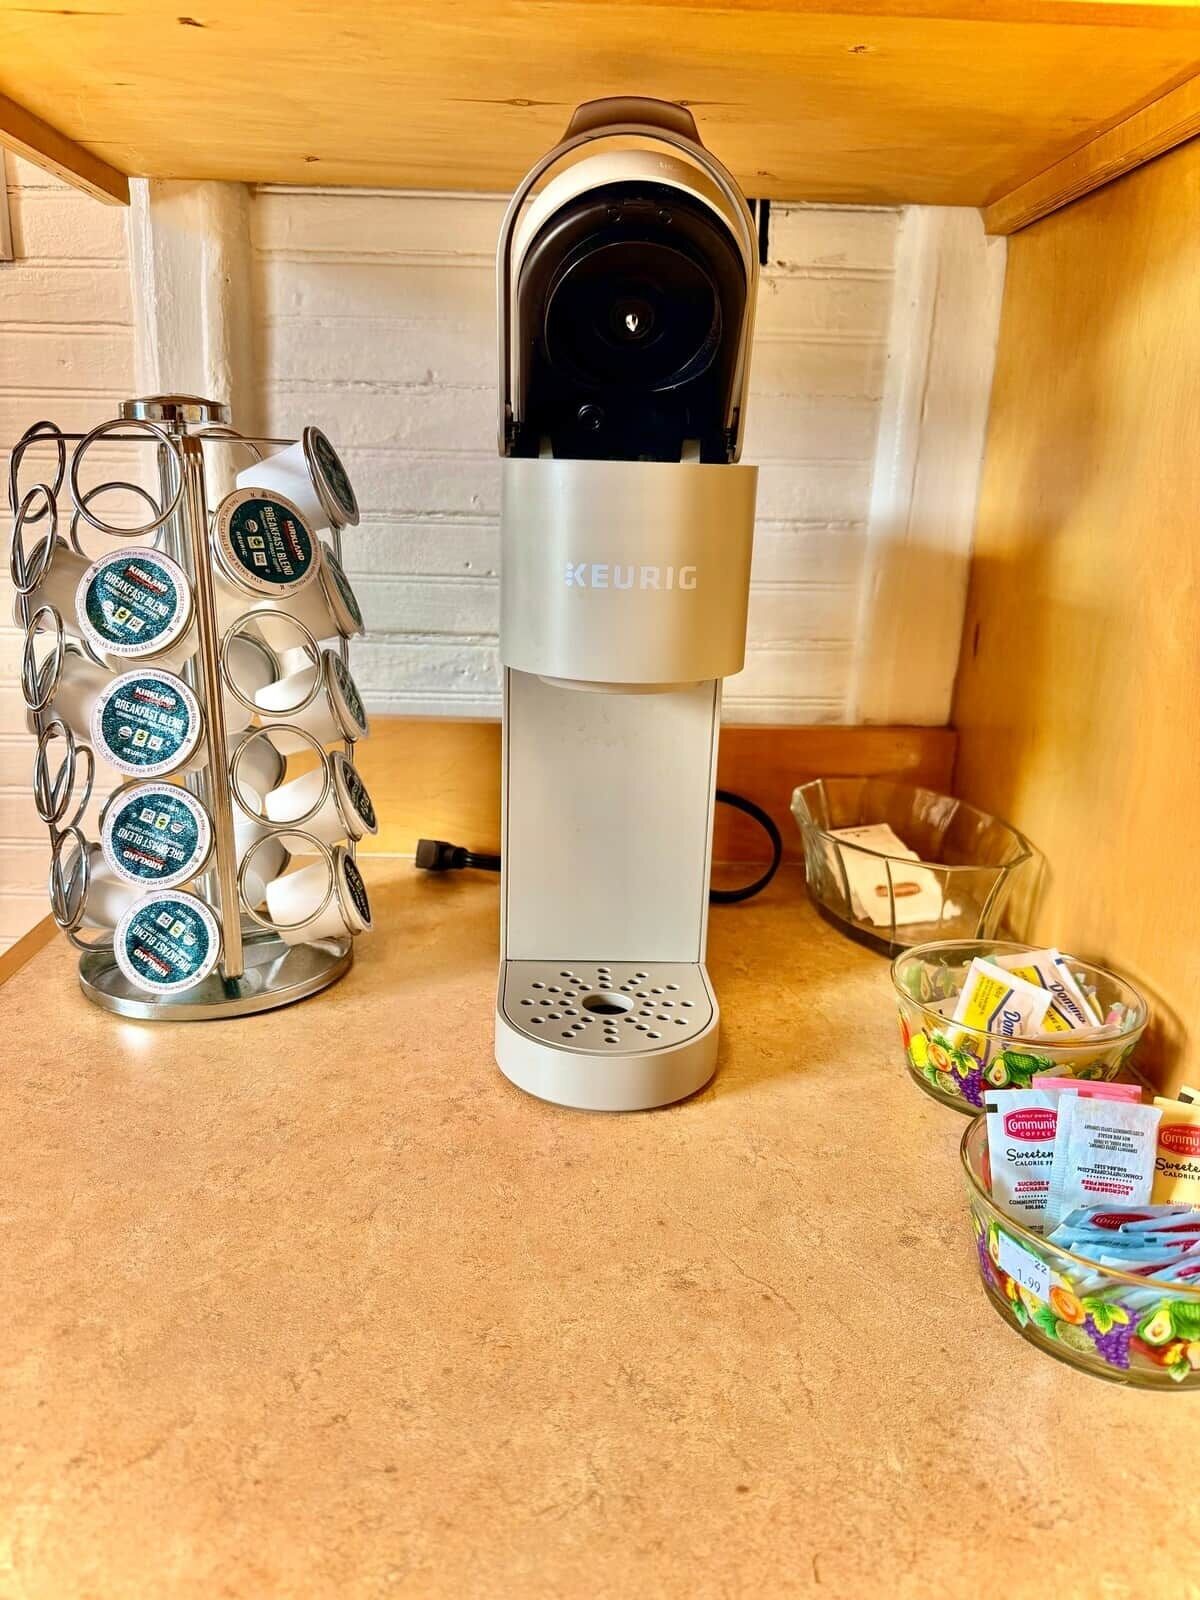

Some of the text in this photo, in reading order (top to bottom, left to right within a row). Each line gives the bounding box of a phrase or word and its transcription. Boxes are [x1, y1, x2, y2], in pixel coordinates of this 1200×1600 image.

[263, 506, 295, 576] BREAKFAST BLEND
[286, 519, 305, 561] KIRKLAND
[128, 565, 169, 593] KIRKLAND
[565, 562, 697, 590] KEURIG
[103, 571, 148, 603] BREAKFAST
[143, 596, 170, 616] BLEND
[135, 686, 177, 706] KIRKLAND
[114, 698, 160, 721] BREAKFAST
[159, 714, 185, 730] BLEND
[118, 827, 186, 861] BREAKFAST BLEND
[123, 850, 164, 872] KIRKLAND
[132, 925, 192, 973] BREAKFAST BLEND
[134, 948, 169, 978] KIRKLAND
[1049, 980, 1087, 1025] Domino
[1001, 1010, 1021, 1050] Dom
[1008, 1118, 1057, 1133] Communit
[1161, 1130, 1200, 1146] Commu
[1006, 1148, 1054, 1162] Sweeten
[1155, 1157, 1200, 1173] Sweete
[1017, 1267, 1041, 1293] 1.99
[1034, 1260, 1048, 1274] 22
